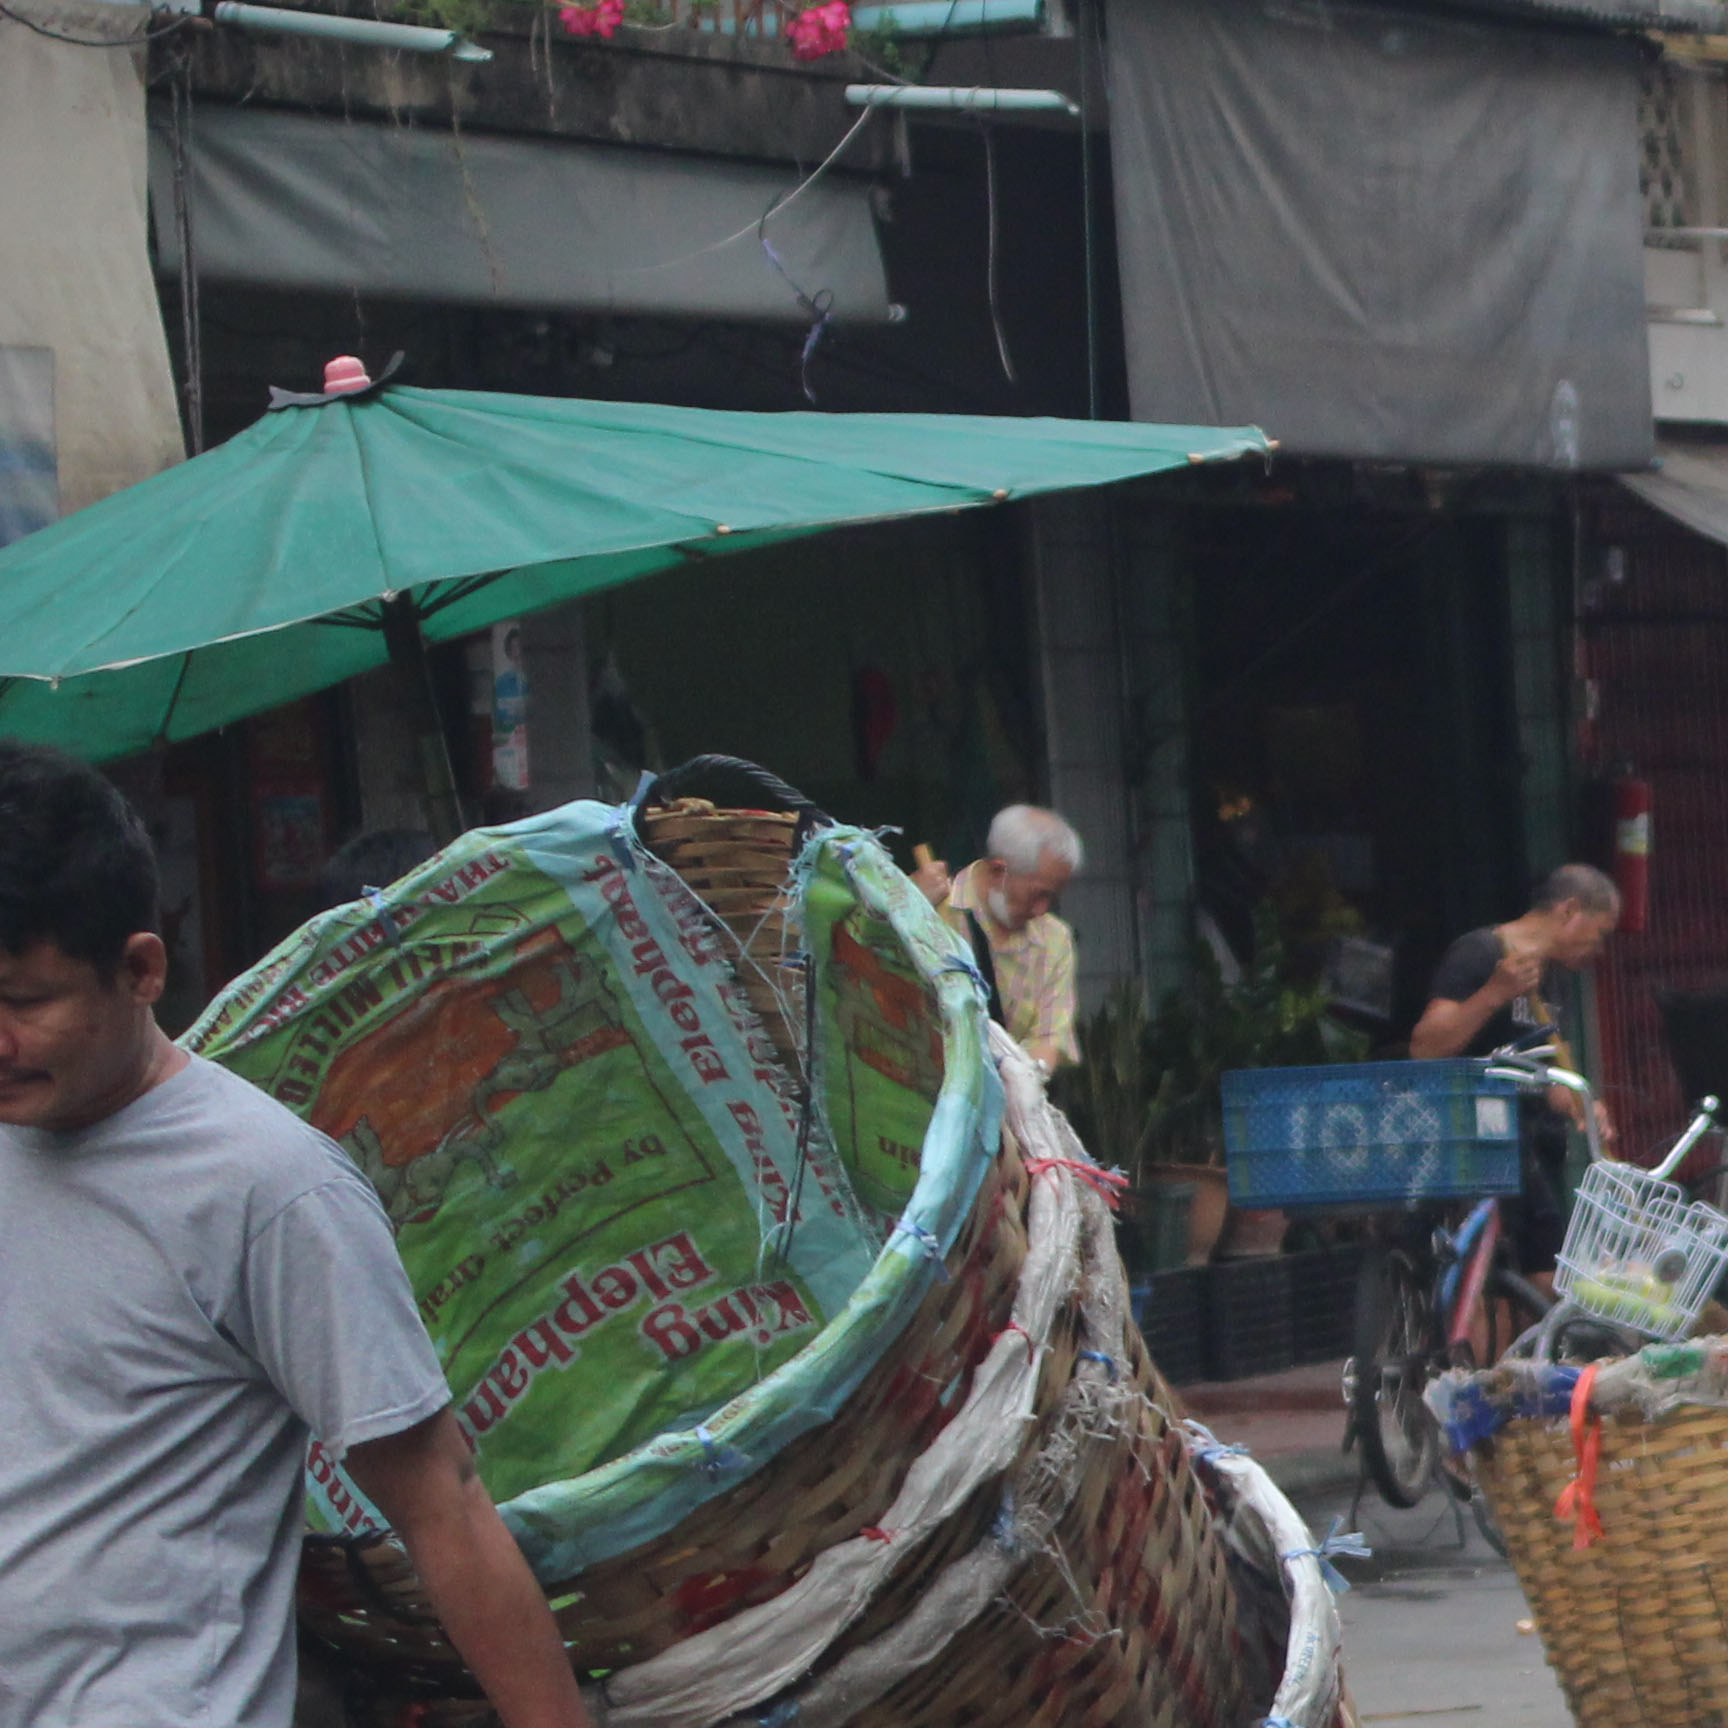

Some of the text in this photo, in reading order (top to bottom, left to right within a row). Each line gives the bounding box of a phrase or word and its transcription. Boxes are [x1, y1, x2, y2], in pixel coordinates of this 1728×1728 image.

[274, 974, 385, 1106] MILLED
[624, 1133, 667, 1167] by
[727, 1101, 802, 1224] King
[456, 1231, 714, 1455] Elephan
[642, 1280, 813, 1360] King
[308, 1440, 377, 1535] ing
